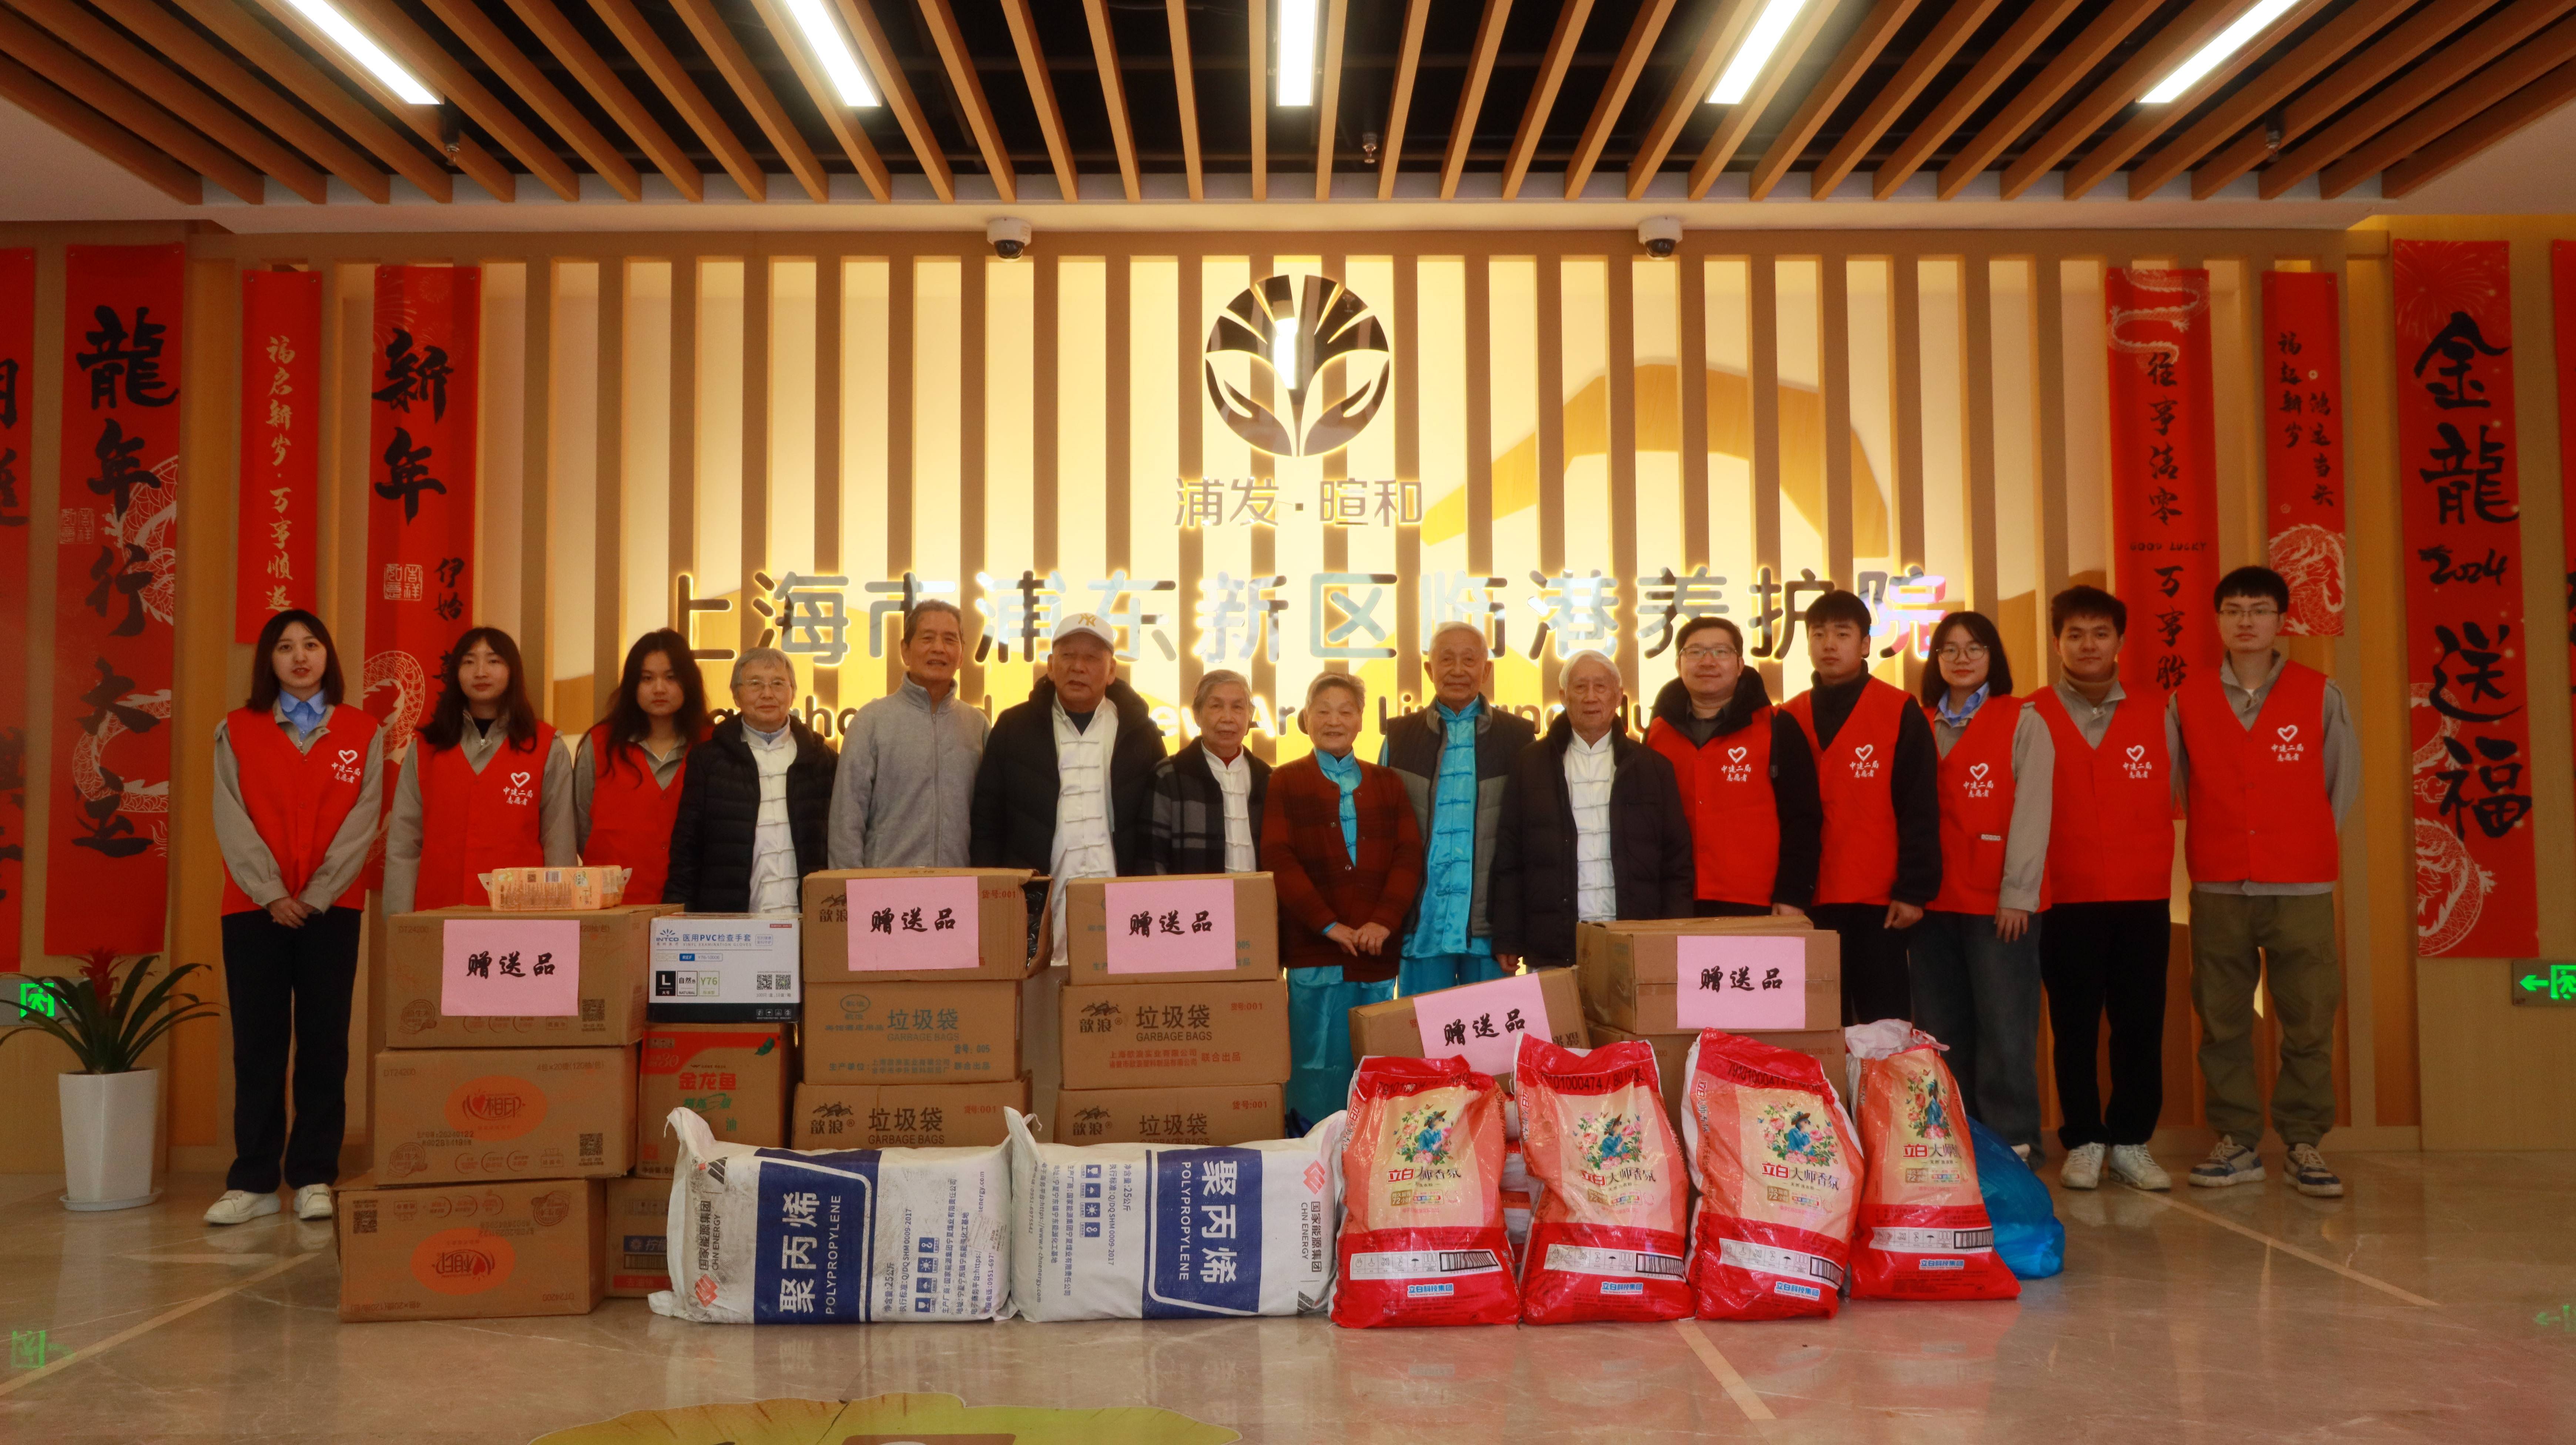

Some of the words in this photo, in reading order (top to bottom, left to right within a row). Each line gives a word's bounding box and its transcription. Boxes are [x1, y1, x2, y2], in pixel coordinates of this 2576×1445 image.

[371, 327, 455, 526] 新年
[1175, 477, 1423, 527] 浦发·暄和
[2418, 544, 2509, 586] 2024
[677, 569, 1948, 663] 上海市浦东新区临港养护院
[2429, 621, 2532, 839] 送福
[1721, 764, 1751, 774] 中建二局
[1726, 773, 1748, 782] 志愿者
[1849, 760, 1879, 771] 中建二局
[1963, 780, 1994, 790] 中建二局
[982, 889, 1017, 899] 货号:001
[870, 907, 956, 935] 赠送品
[1128, 909, 1213, 938] 赠送品
[682, 934, 751, 942] 医用PVC检查手套
[466, 950, 556, 979] 赠送品
[661, 974, 671, 986] L
[700, 977, 718, 985] Y76
[1699, 965, 1783, 993] 赠送品
[1136, 1004, 1211, 1029] 垃圾袋
[1230, 1002, 1263, 1011] 货号:001
[887, 1008, 959, 1031] 垃圾袋
[1443, 1008, 1526, 1046] 赠送品
[887, 1033, 933, 1042] GARBAGE
[935, 1033, 959, 1041] BAGS
[1136, 1032, 1183, 1042] GARBAGE
[1185, 1031, 1212, 1041] BAGS
[1201, 1051, 1241, 1063] 联合出品
[678, 1072, 737, 1090] 金龙鱼
[1232, 1100, 1268, 1109] 货号:001
[868, 1107, 943, 1132] 垃圾袋
[1139, 1113, 1208, 1136] 垃圾袋
[868, 1135, 916, 1144] GARBAGE
[918, 1135, 945, 1144] BAGS
[1902, 1143, 1929, 1159] 立白
[1387, 1167, 1415, 1183] 立白
[1761, 1161, 1790, 1180] 立白
[1791, 1167, 1839, 1191] 大师香氛
[1123, 1164, 1132, 1212] 净含量:25公斤
[712, 1214, 721, 1248] ENERGY
[1179, 1161, 1191, 1281] POLYPROPYLENE
[1200, 1160, 1238, 1284] 聚丙烯
[698, 1200, 712, 1270] 国家能源集团
[1300, 1221, 1308, 1260] ENERGY
[1310, 1201, 1322, 1273] 国家能源集团
[711, 1248, 721, 1270] CHN
[779, 1191, 820, 1313] 聚丙烯
[825, 1194, 841, 1315] POLYPROPYLENE
[885, 1262, 894, 1312] 净含量:25公斤
[1408, 1284, 1453, 1293] 立白科技集团
[1602, 1282, 1643, 1291] 立白科技集团
[1775, 1282, 1819, 1296] 立白科技集团
